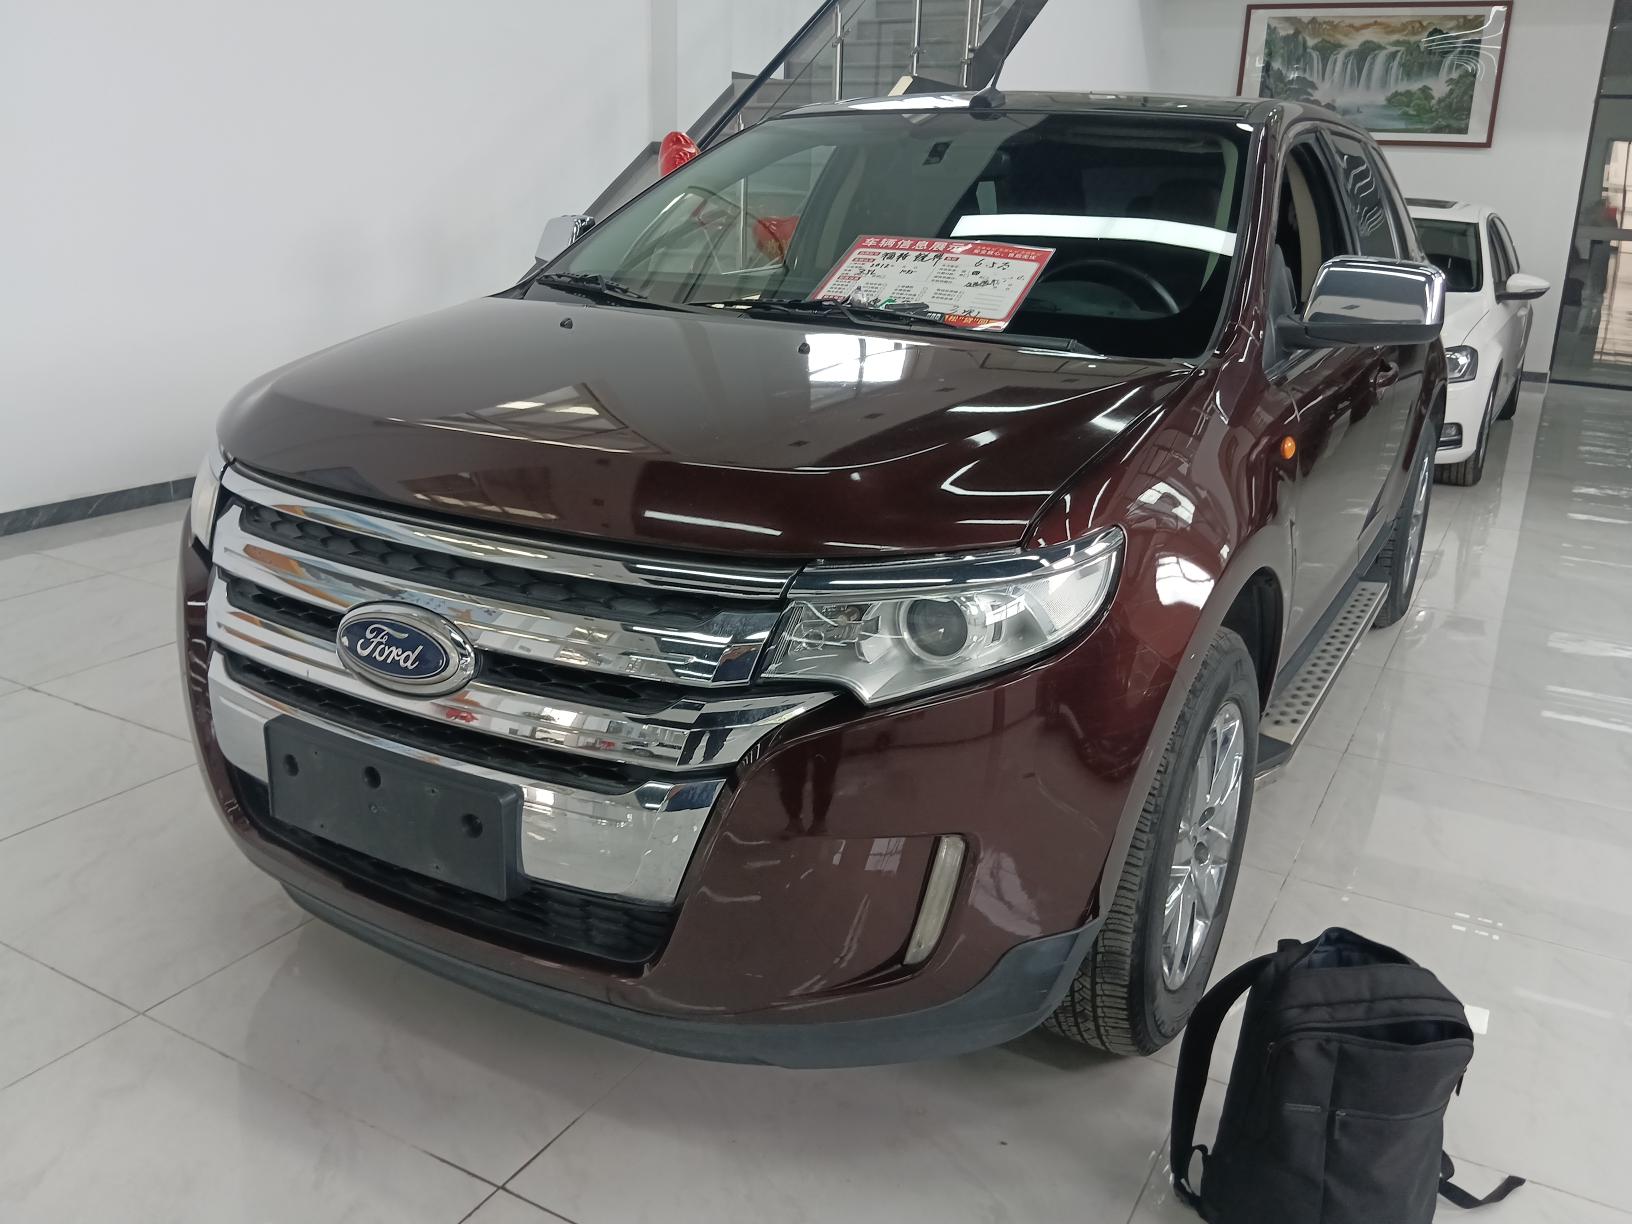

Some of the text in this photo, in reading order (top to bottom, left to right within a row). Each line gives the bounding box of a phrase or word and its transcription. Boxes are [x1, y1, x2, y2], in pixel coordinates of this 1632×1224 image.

[862, 237, 966, 253] 车辆信息展示
[356, 623, 424, 670] Ford
